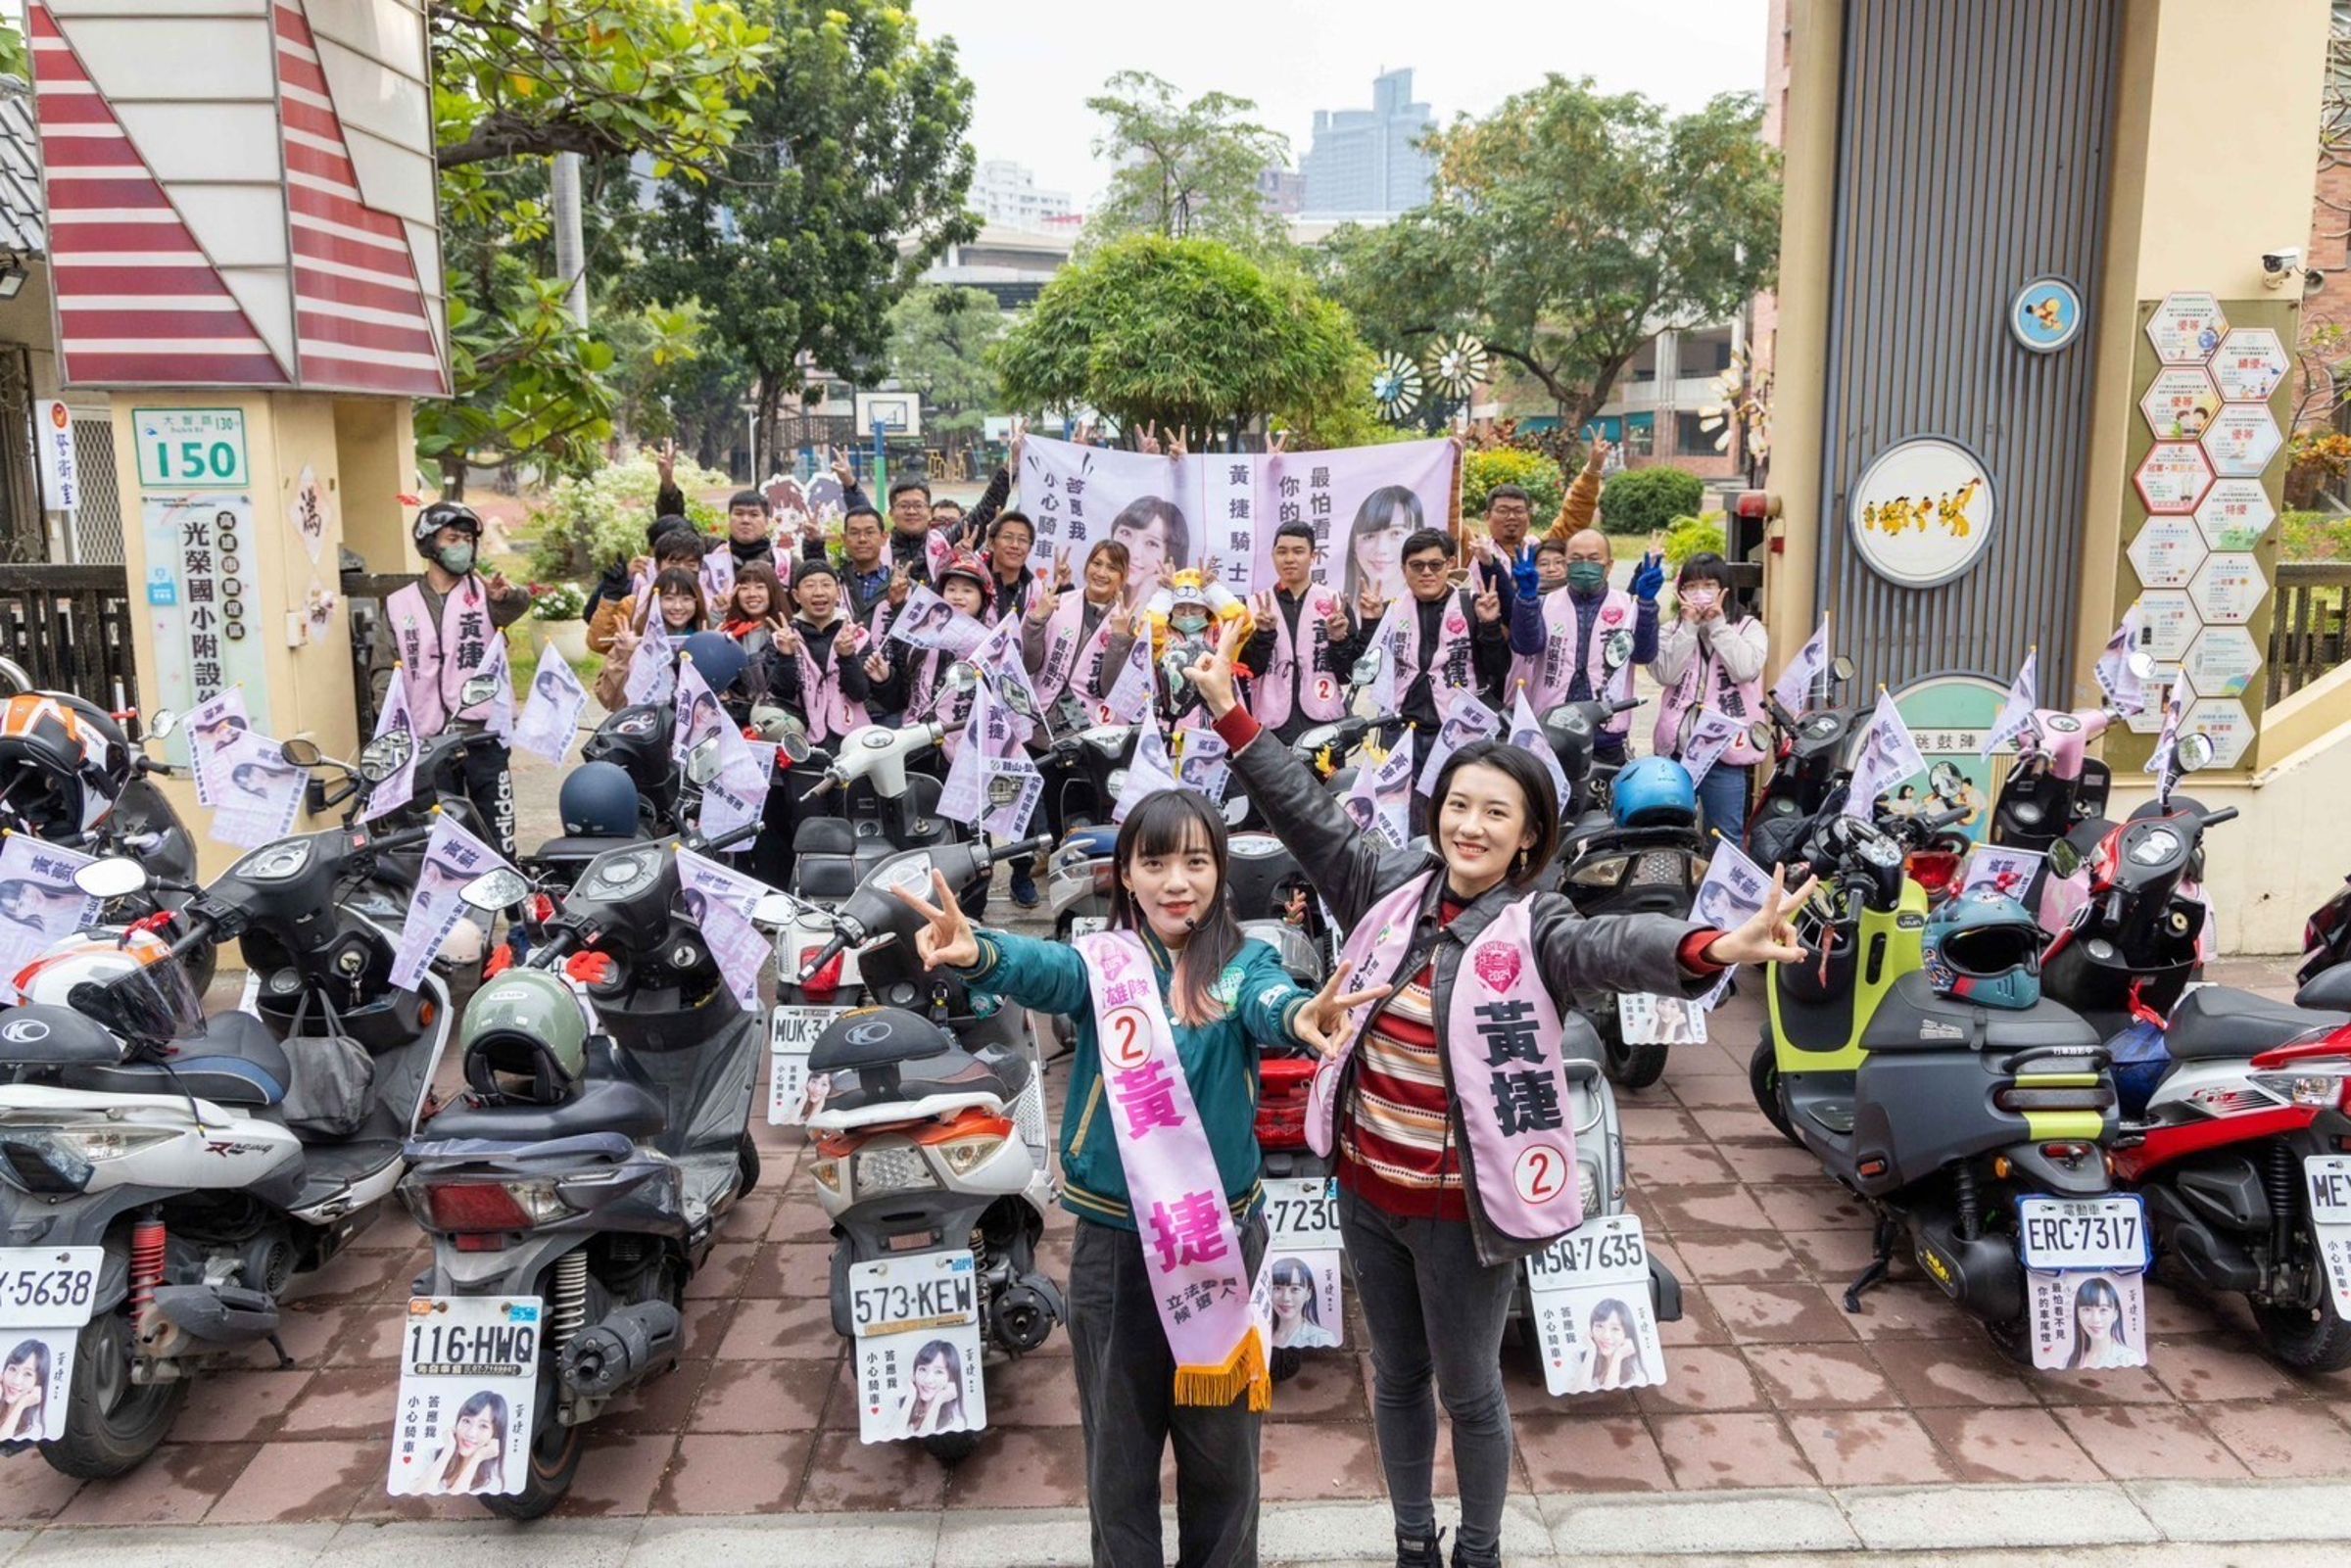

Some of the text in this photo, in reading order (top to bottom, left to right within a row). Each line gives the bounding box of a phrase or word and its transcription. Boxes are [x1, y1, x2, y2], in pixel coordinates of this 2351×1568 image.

[158, 442, 236, 478] 150
[1035, 472, 1060, 558] 小心騎車
[1278, 476, 1301, 522] 你的
[1310, 466, 1332, 586] 最怕看不見
[457, 611, 485, 671] 黃捷
[1319, 680, 1329, 698] 2
[988, 705, 1005, 740] 黃捷
[1100, 705, 1111, 724] 2
[1378, 752, 1409, 782] 黃捷
[495, 770, 514, 853] adidas
[1102, 979, 1151, 1008] 雄隊
[1115, 1015, 1144, 1063] 2
[1474, 1000, 1563, 1137] 黃捷
[1113, 1060, 1229, 1276] 黃捷
[1528, 1153, 1553, 1197] 2
[2062, 1204, 2100, 1216] 電動車
[1174, 1286, 1237, 1325] 候選人
[2038, 1286, 2051, 1343] 你的車尾燈
[1543, 1308, 1561, 1358] 小心騎車
[867, 1353, 880, 1405] 小心騎車
[403, 1396, 420, 1453] 小心騎車
[423, 1396, 441, 1439] 答應我
